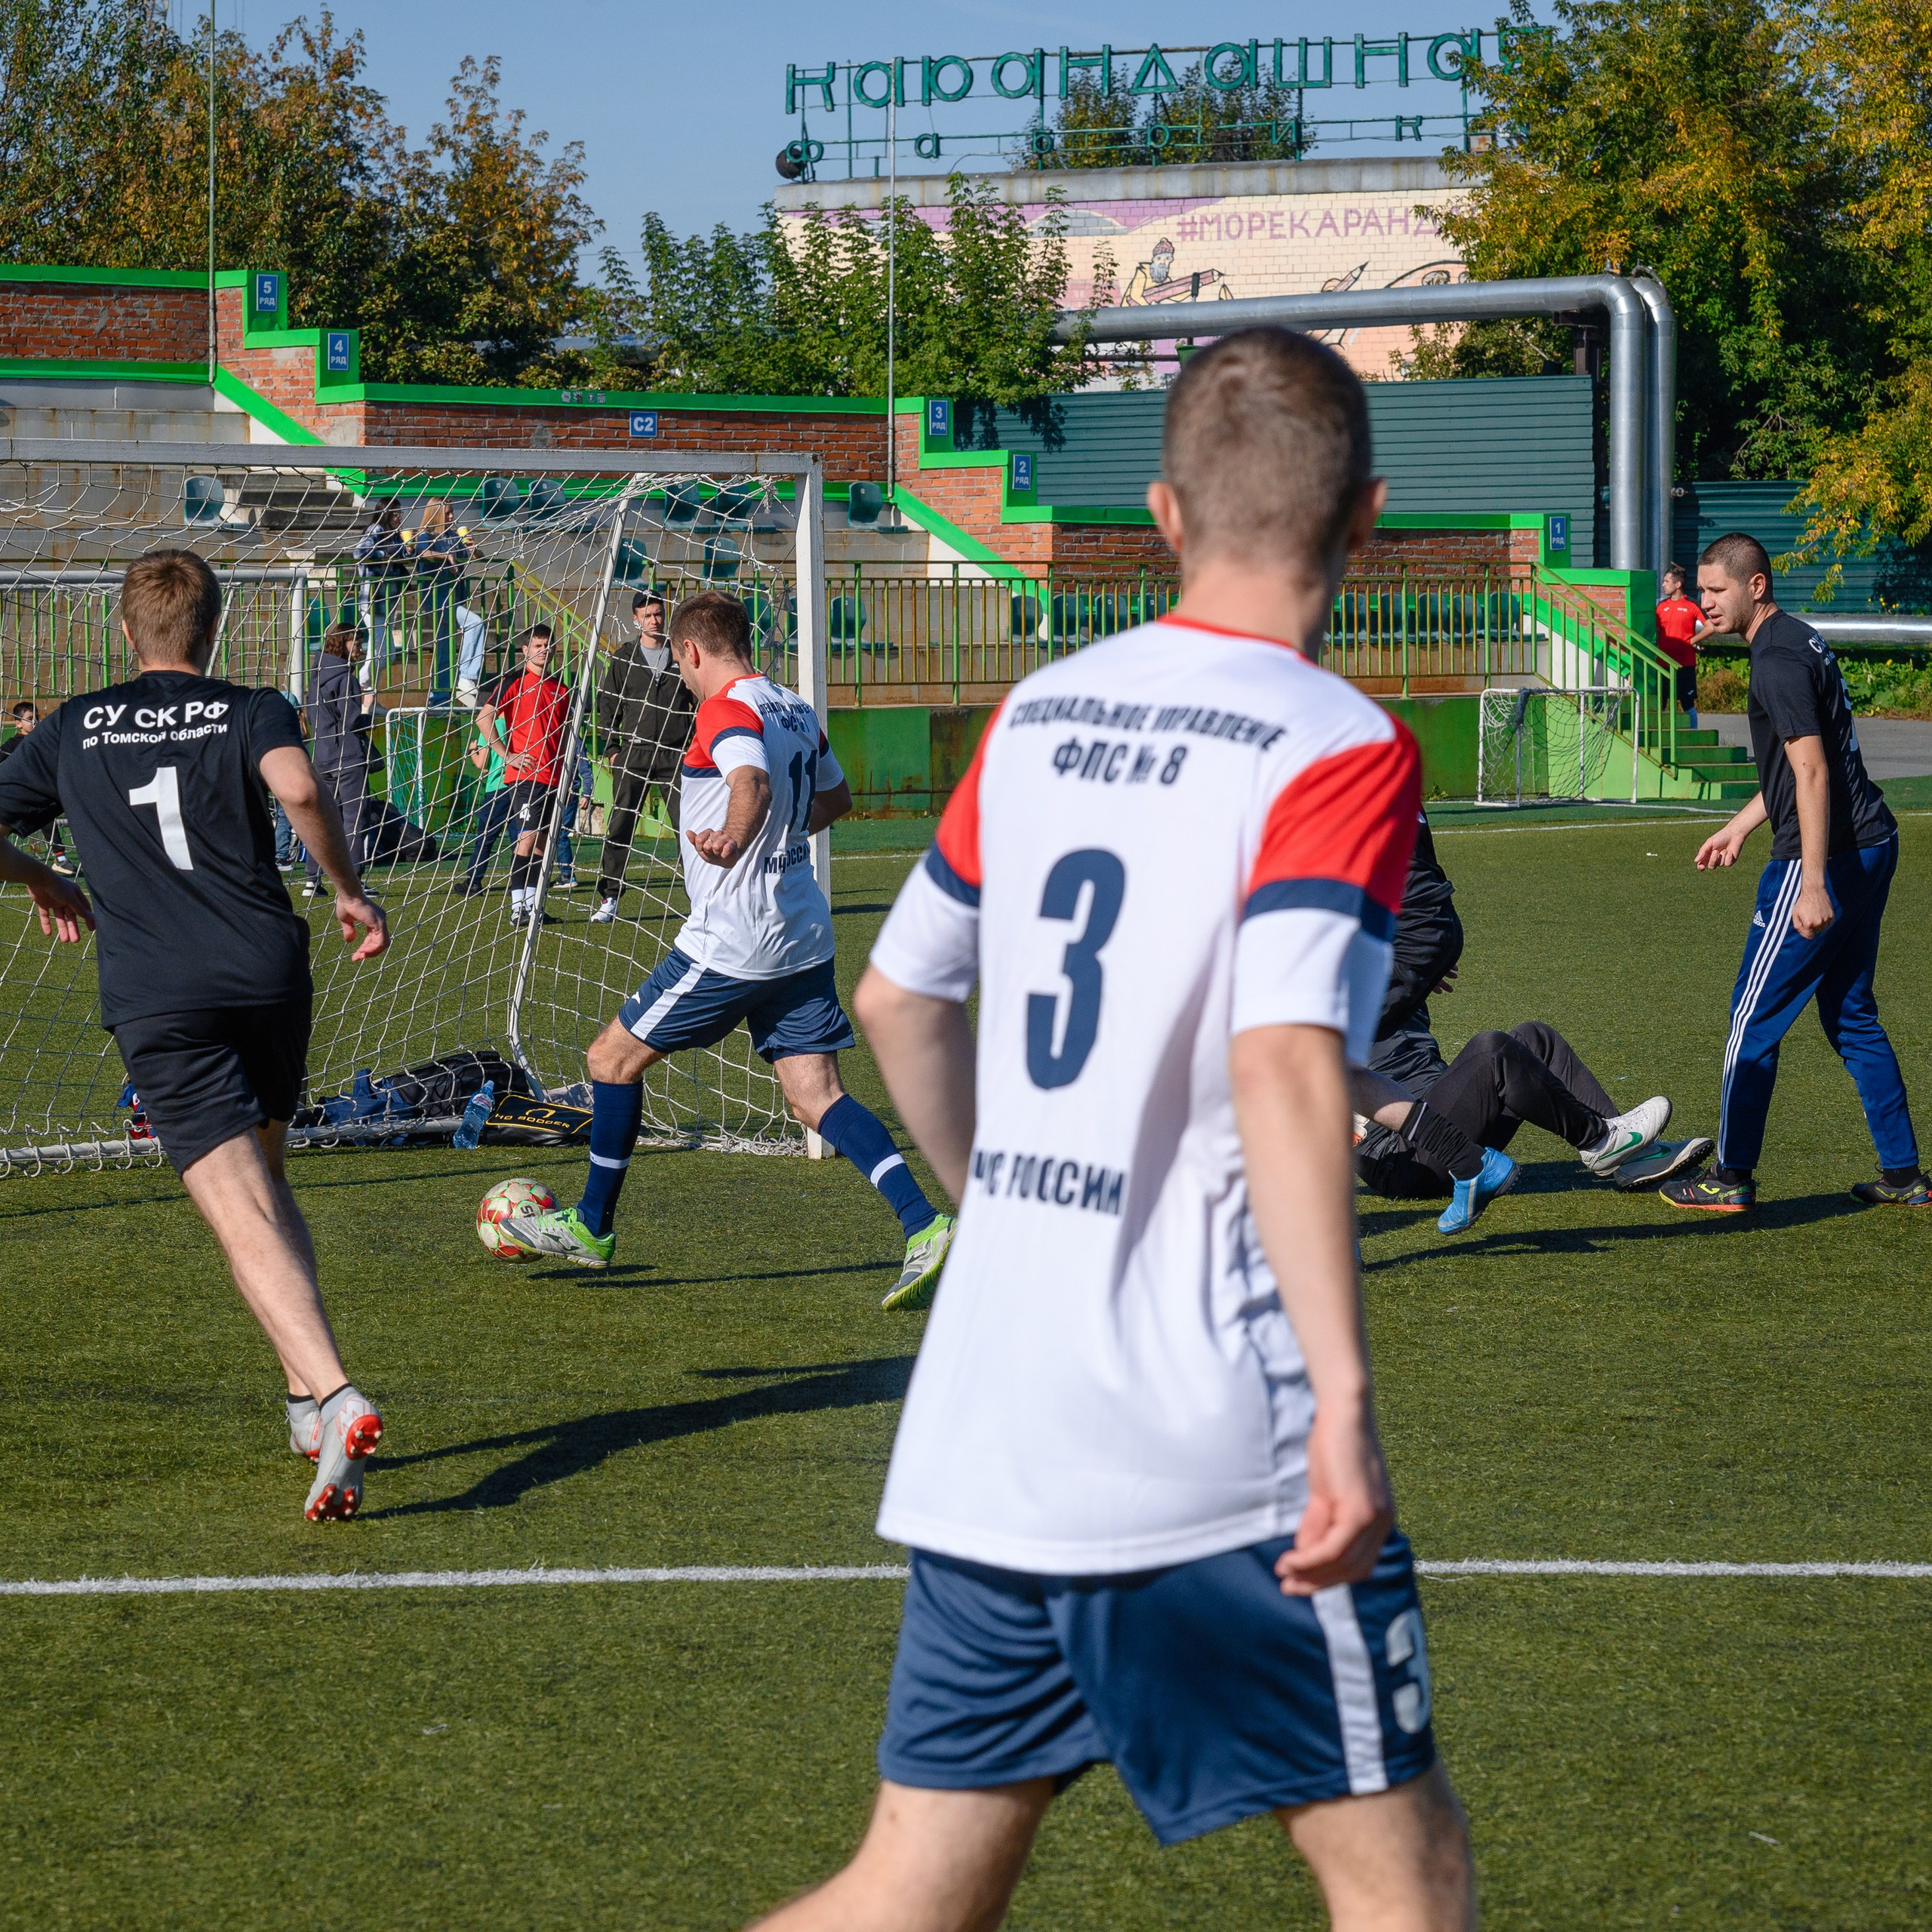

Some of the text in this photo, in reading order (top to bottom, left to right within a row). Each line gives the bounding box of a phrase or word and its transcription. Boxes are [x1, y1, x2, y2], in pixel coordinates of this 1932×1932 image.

[785, 113, 1529, 165] фабрик
[263, 281, 272, 294] 5
[259, 297, 275, 306] РЯД
[334, 340, 343, 352] 4
[331, 356, 347, 365] РЯД
[935, 406, 943, 419] 3
[931, 422, 946, 430] РЯД
[1019, 460, 1026, 473] 2
[1015, 476, 1029, 485] РЯД
[1555, 521, 1561, 534] 1
[1552, 537, 1564, 546] РЯД
[83, 701, 229, 729] СУ СК РФ
[82, 723, 227, 749] по Томской области
[1052, 735, 1129, 783] ФПС
[1159, 745, 1188, 786] 8
[788, 749, 818, 833] 11
[128, 766, 194, 870] 1
[519, 804, 531, 820] 4
[1025, 848, 1127, 1091] 3
[1386, 1607, 1431, 1734] 3
